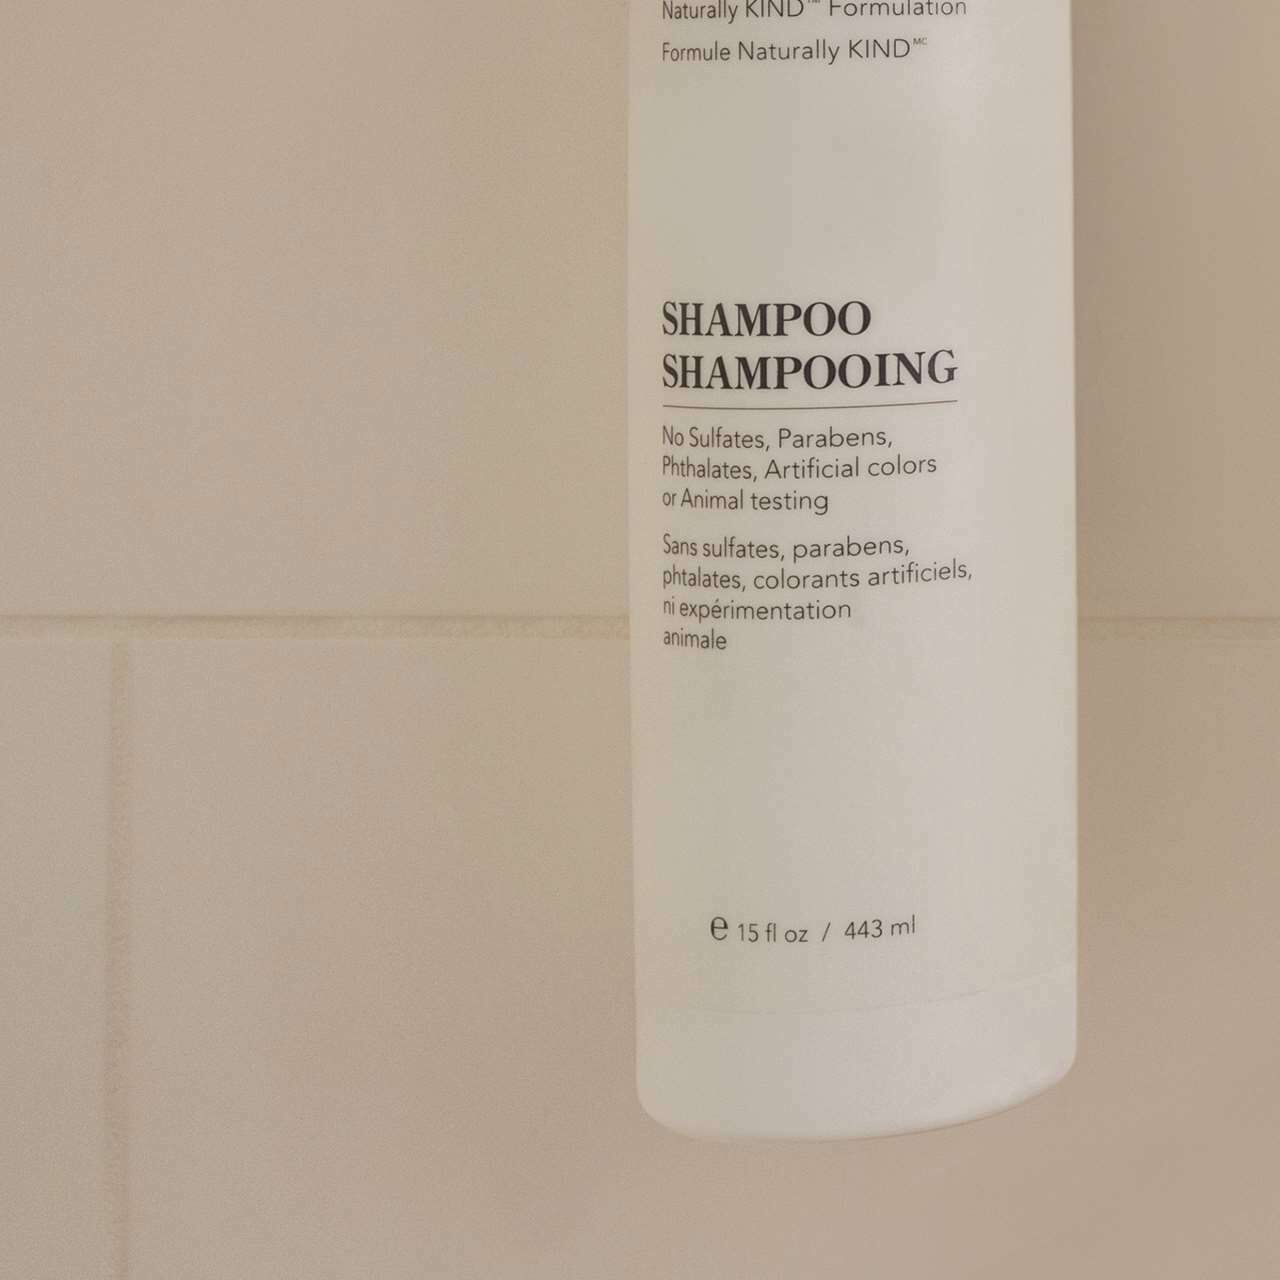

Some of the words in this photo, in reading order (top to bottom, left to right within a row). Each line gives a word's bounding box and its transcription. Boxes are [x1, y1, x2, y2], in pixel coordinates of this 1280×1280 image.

[662, 40, 731, 62] Formule
[738, 38, 840, 65] Naturally
[662, 300, 872, 337] SHAMPOO
[662, 349, 959, 391] SHAMPOOING
[662, 425, 684, 446] No
[689, 426, 770, 452] Sulfates,
[778, 426, 892, 448] Parabens,
[663, 454, 757, 483] Phthalates,
[764, 456, 859, 479] Artificial
[867, 453, 937, 477] colors
[662, 492, 677, 507] or
[680, 488, 743, 510] Animal
[750, 490, 830, 516] testing
[663, 533, 699, 556] Sans
[702, 536, 784, 562] sulfates,
[793, 535, 912, 565] parabens,
[663, 563, 746, 592] phtalates,
[754, 568, 860, 590] colorants
[868, 558, 972, 586] artificiels,
[664, 597, 675, 616] ni
[679, 598, 851, 624] expérimentation
[663, 627, 728, 650] animale
[738, 923, 759, 943] 15
[764, 922, 776, 944] fl
[784, 928, 808, 943] oz
[821, 921, 831, 942] /
[844, 918, 883, 940] 443
[891, 914, 915, 936] ml
